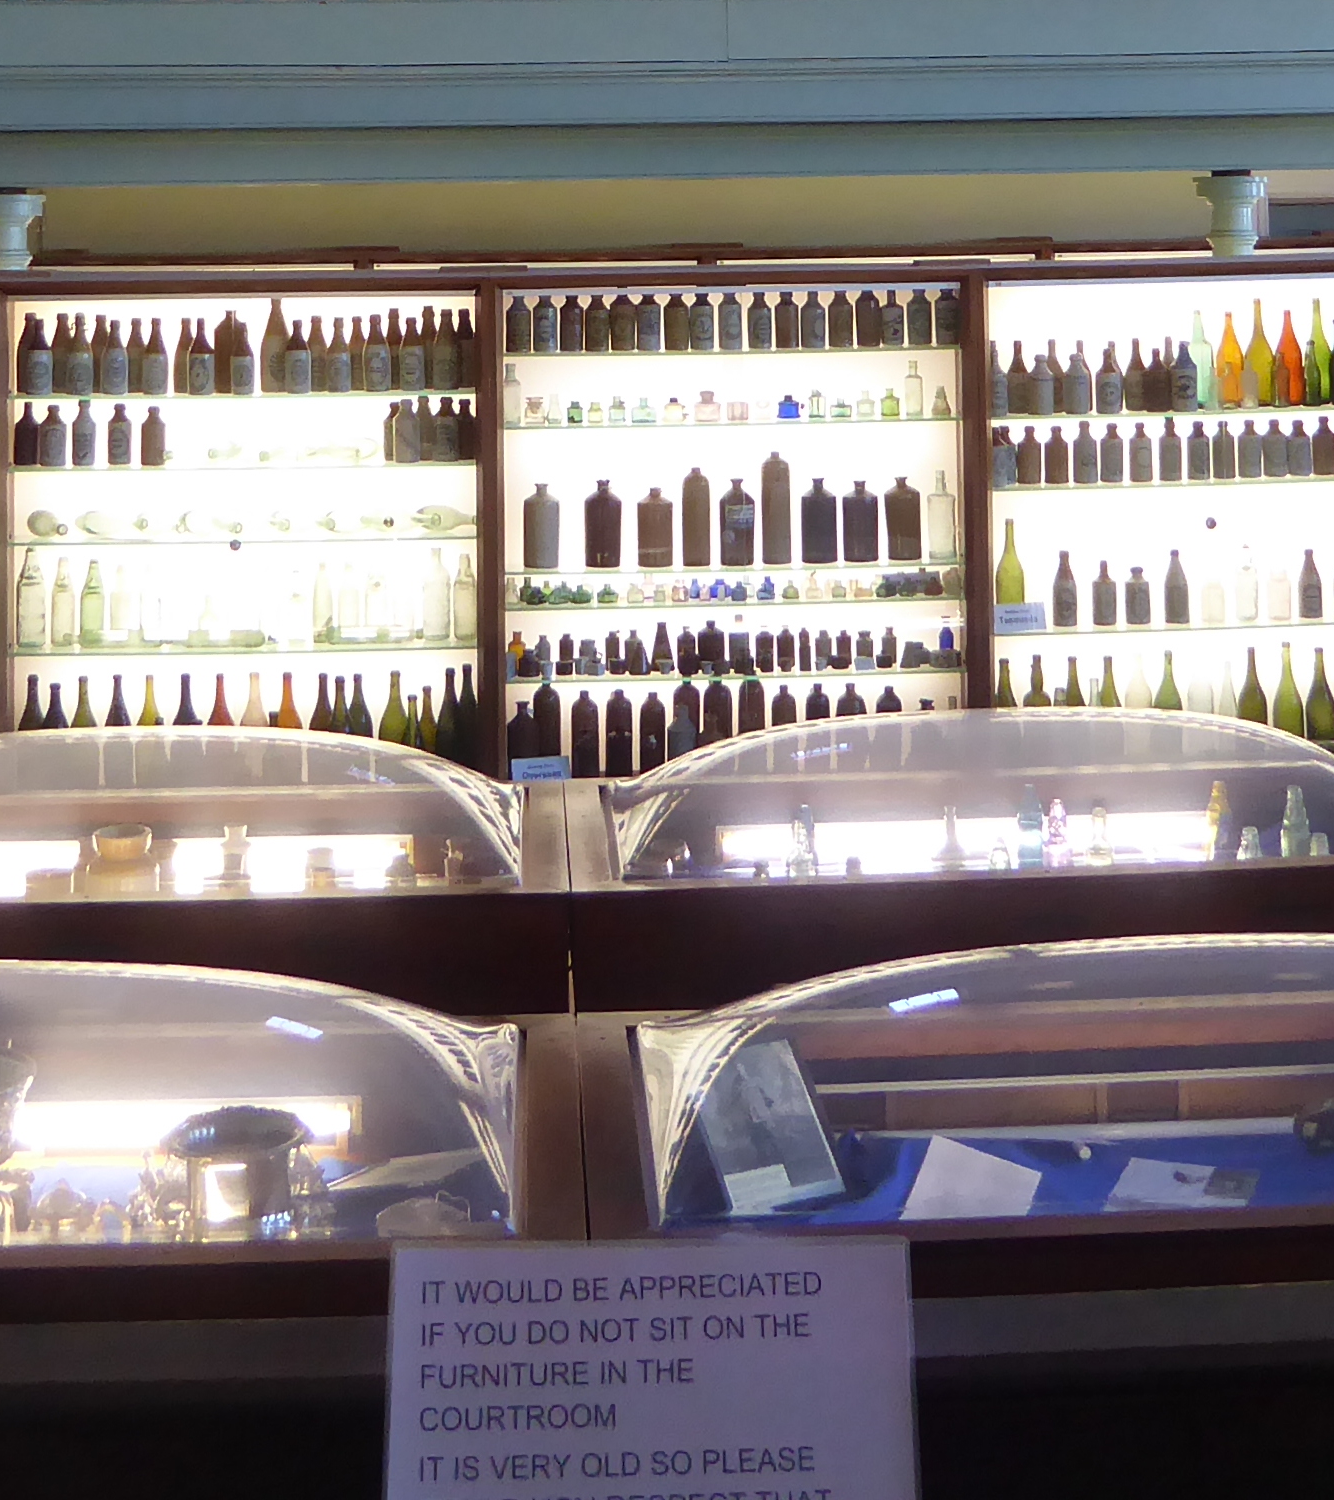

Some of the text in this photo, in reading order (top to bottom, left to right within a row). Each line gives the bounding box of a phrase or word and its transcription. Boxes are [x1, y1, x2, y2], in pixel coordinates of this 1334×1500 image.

[421, 1271, 823, 1305] IT WOULD BE APPRECIATED
[421, 1312, 811, 1347] IF YOU DO NOT SIT ON THE
[420, 1357, 694, 1390] FURNITURE IN THE
[419, 1403, 617, 1432] COURTROOM
[419, 1445, 815, 1482] IT IS VERY OLD SO PLEASE
